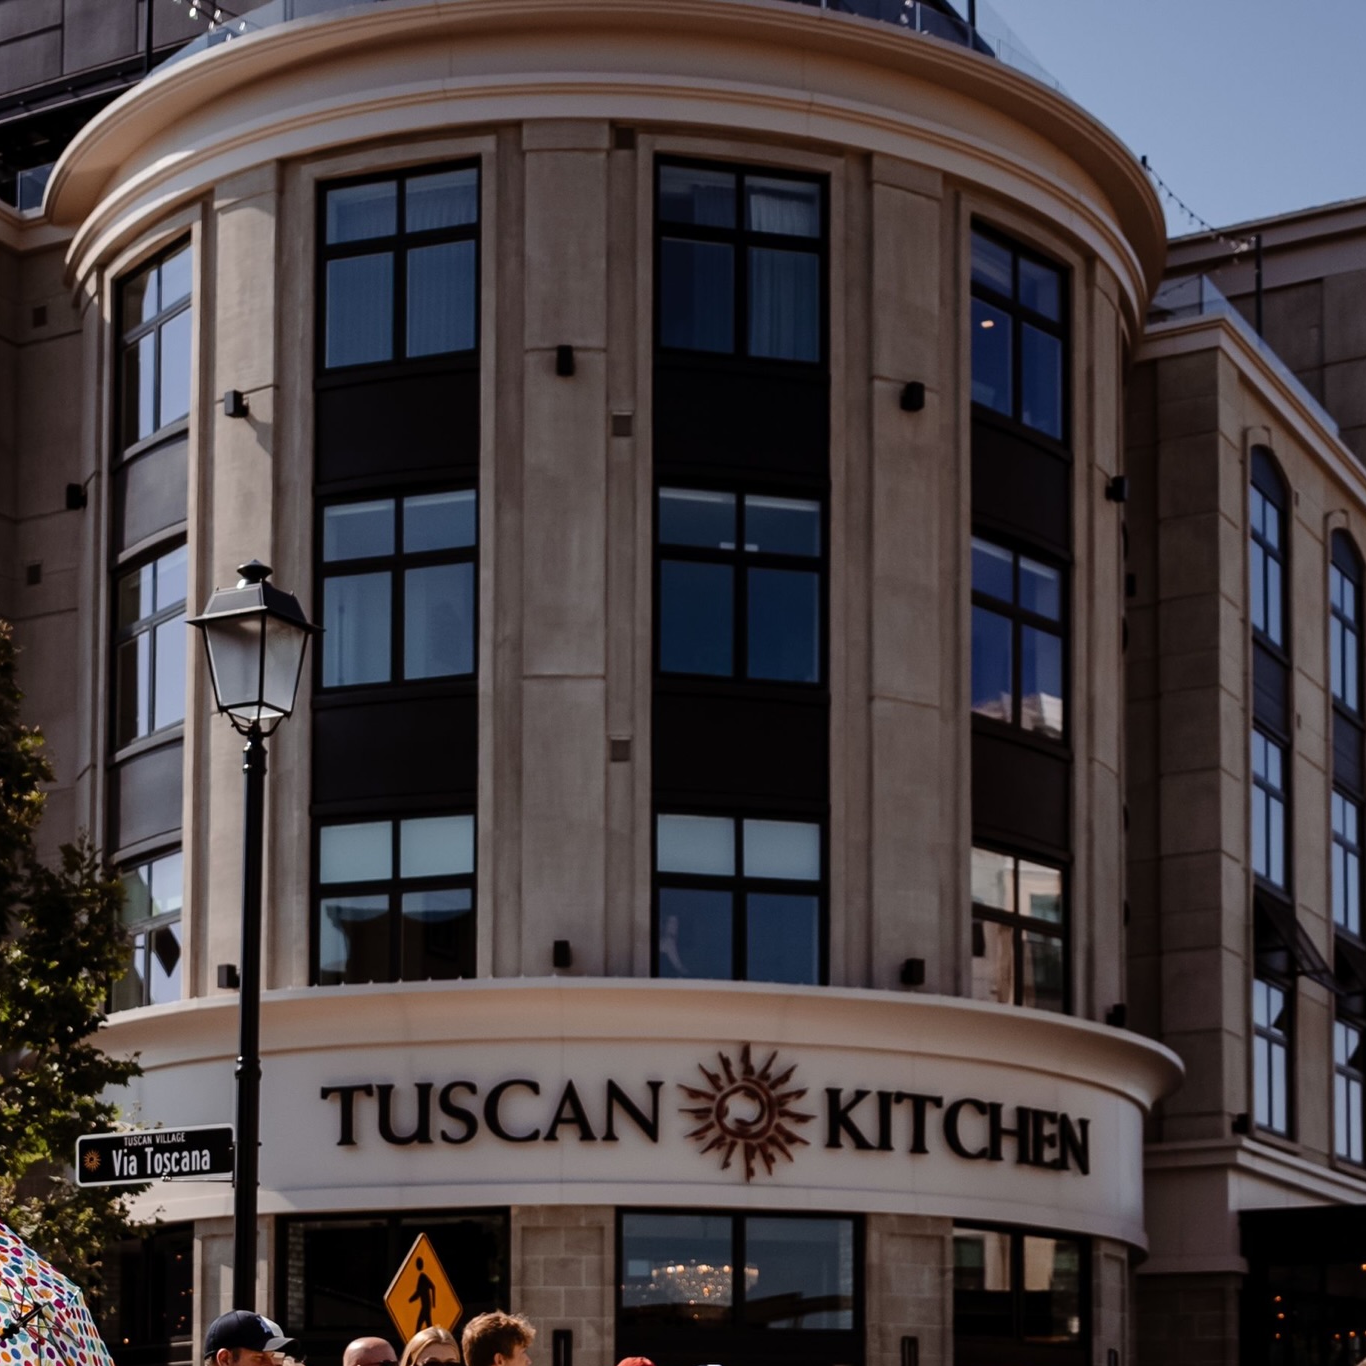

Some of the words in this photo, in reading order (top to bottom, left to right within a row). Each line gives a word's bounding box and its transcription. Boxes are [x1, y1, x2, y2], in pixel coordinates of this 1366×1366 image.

[124, 1136, 153, 1147] TUSCAN
[155, 1132, 186, 1144] VILLAGE
[320, 1078, 665, 1146] TUSCAN
[825, 1087, 1091, 1176] KITCHEN
[112, 1149, 138, 1177] Via
[144, 1147, 211, 1174] Toscana
